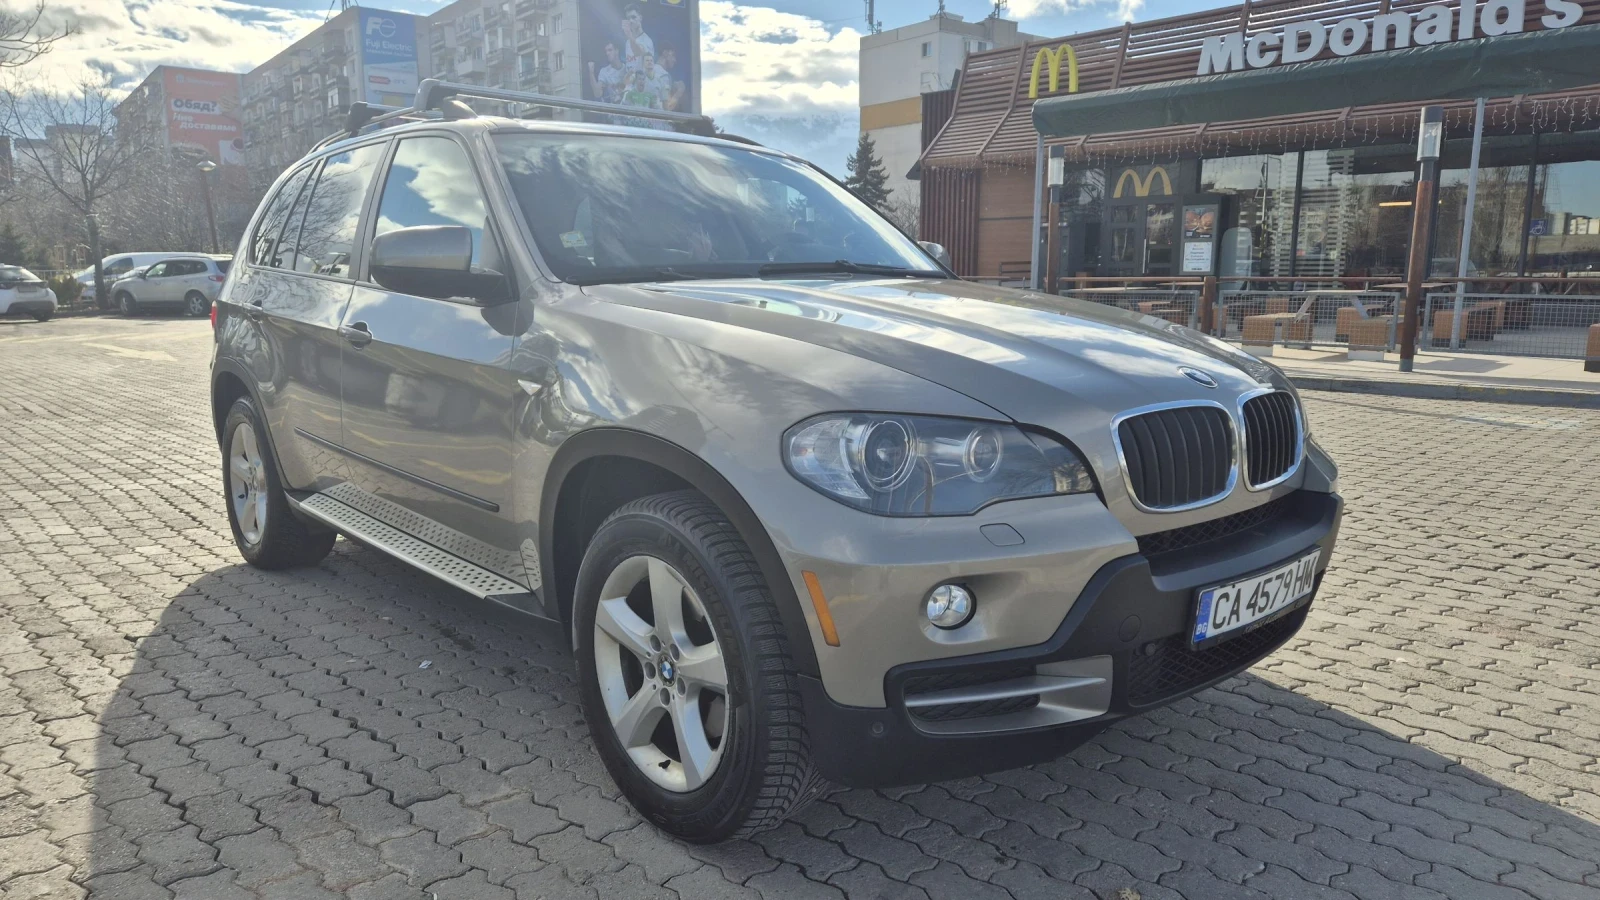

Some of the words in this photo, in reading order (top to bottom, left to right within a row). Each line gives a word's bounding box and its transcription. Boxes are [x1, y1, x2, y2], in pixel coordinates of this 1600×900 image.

[1197, 0, 1583, 75] McDonalds
[365, 38, 381, 50] Fuji
[382, 40, 413, 52] Electric
[173, 98, 217, 112] Обяд?
[1212, 588, 1241, 630] CA
[1246, 568, 1293, 617] 4579
[1292, 556, 1317, 598] HM
[1195, 622, 1207, 635] BG
